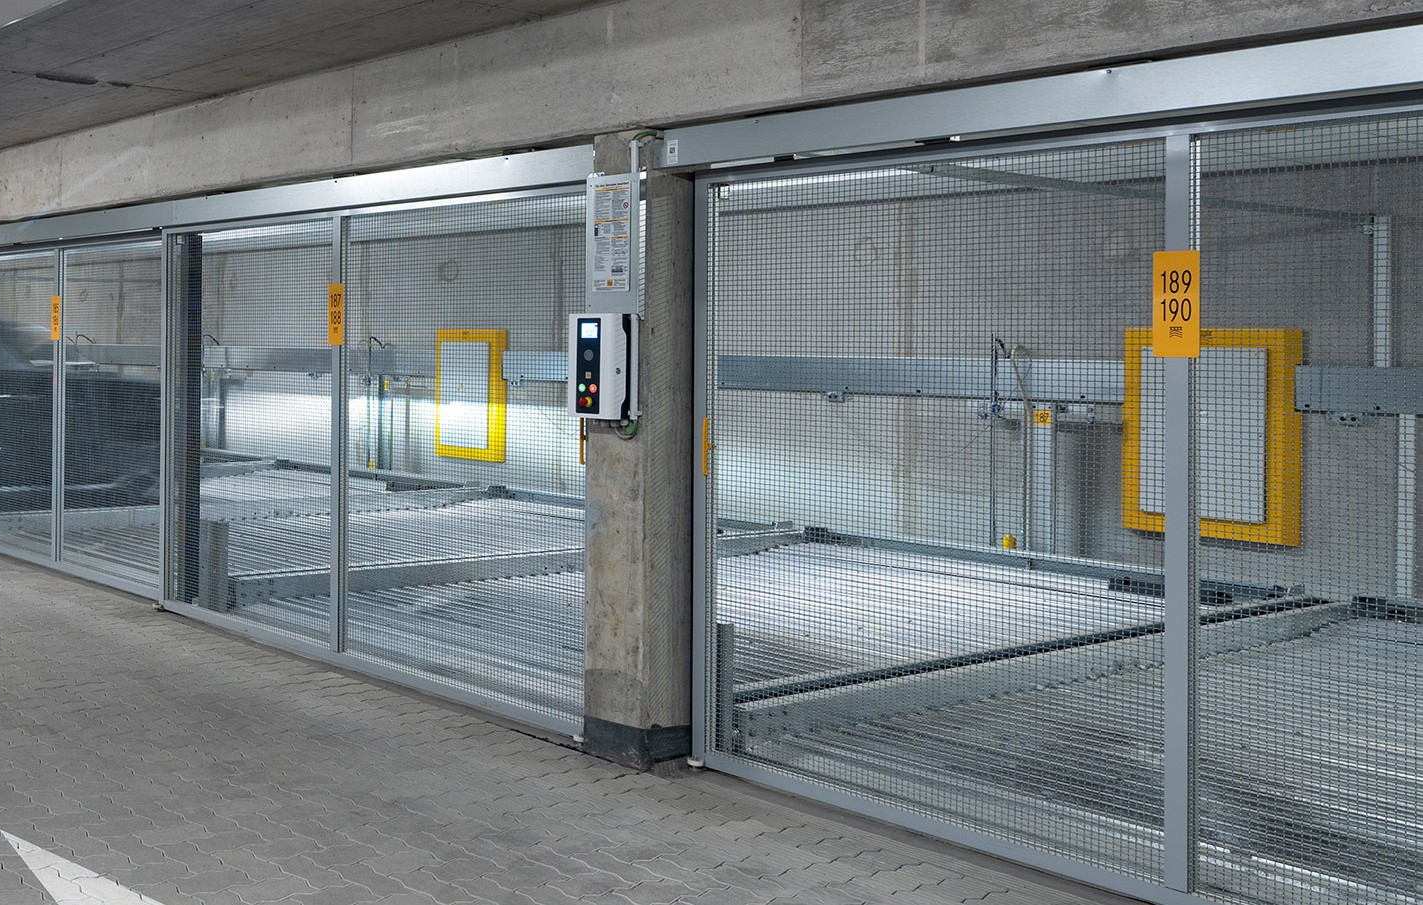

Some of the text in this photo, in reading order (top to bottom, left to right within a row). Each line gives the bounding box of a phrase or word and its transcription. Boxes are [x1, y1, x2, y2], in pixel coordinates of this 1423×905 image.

[1161, 269, 1192, 294] 189
[330, 293, 342, 308] 187
[1161, 298, 1192, 322] 190
[330, 310, 342, 325] 188
